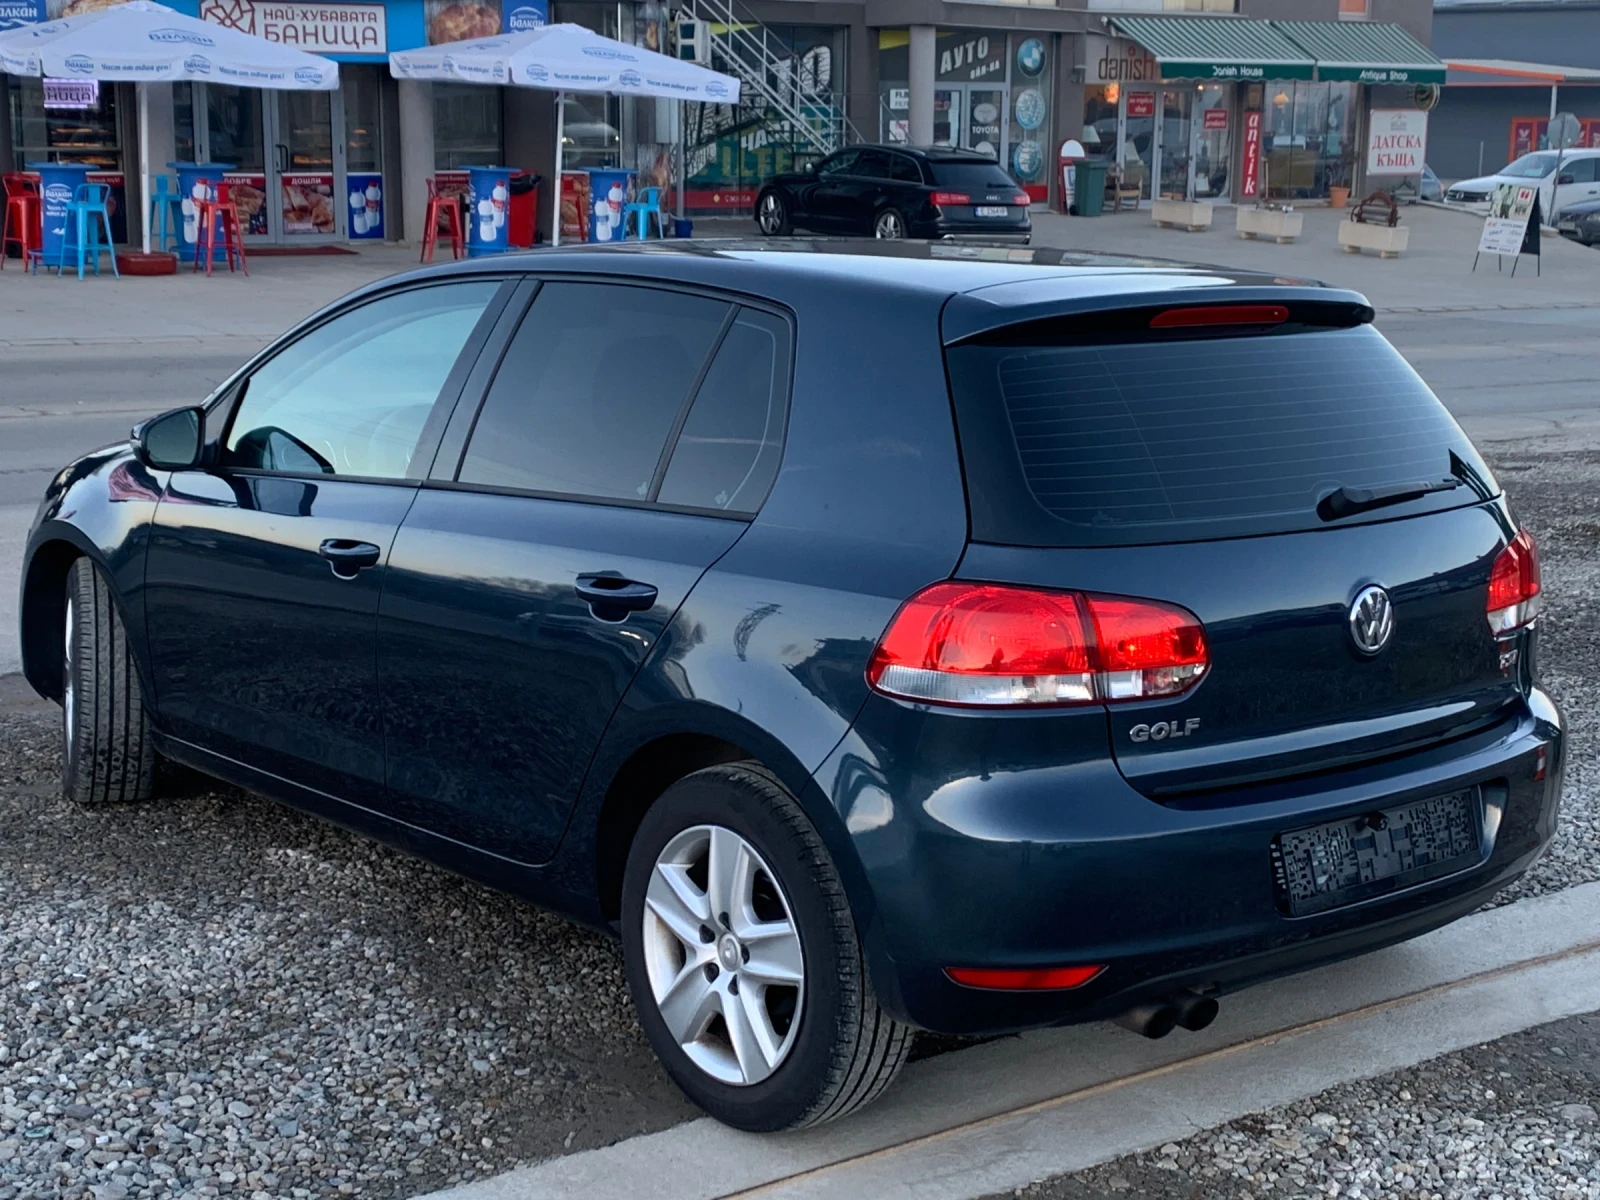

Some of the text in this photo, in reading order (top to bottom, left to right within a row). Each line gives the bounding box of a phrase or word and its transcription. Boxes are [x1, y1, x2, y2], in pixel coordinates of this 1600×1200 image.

[263, 5, 377, 23] НАЙ-ХУБАВАТА
[510, 16, 544, 28] Балкан
[264, 24, 378, 49] БАНИЦА
[1098, 45, 1154, 80] danish
[1240, 66, 1263, 76] House
[1359, 70, 1408, 81] Antique Shop
[44, 92, 91, 102] НИЦА
[972, 126, 999, 134] TOYOTA
[1372, 135, 1421, 150] ДАТСКА
[1244, 114, 1258, 194] antik
[1376, 153, 1415, 167] КЪЩА
[291, 177, 321, 185] ДОШЛИ
[1129, 717, 1200, 743] GOLF
